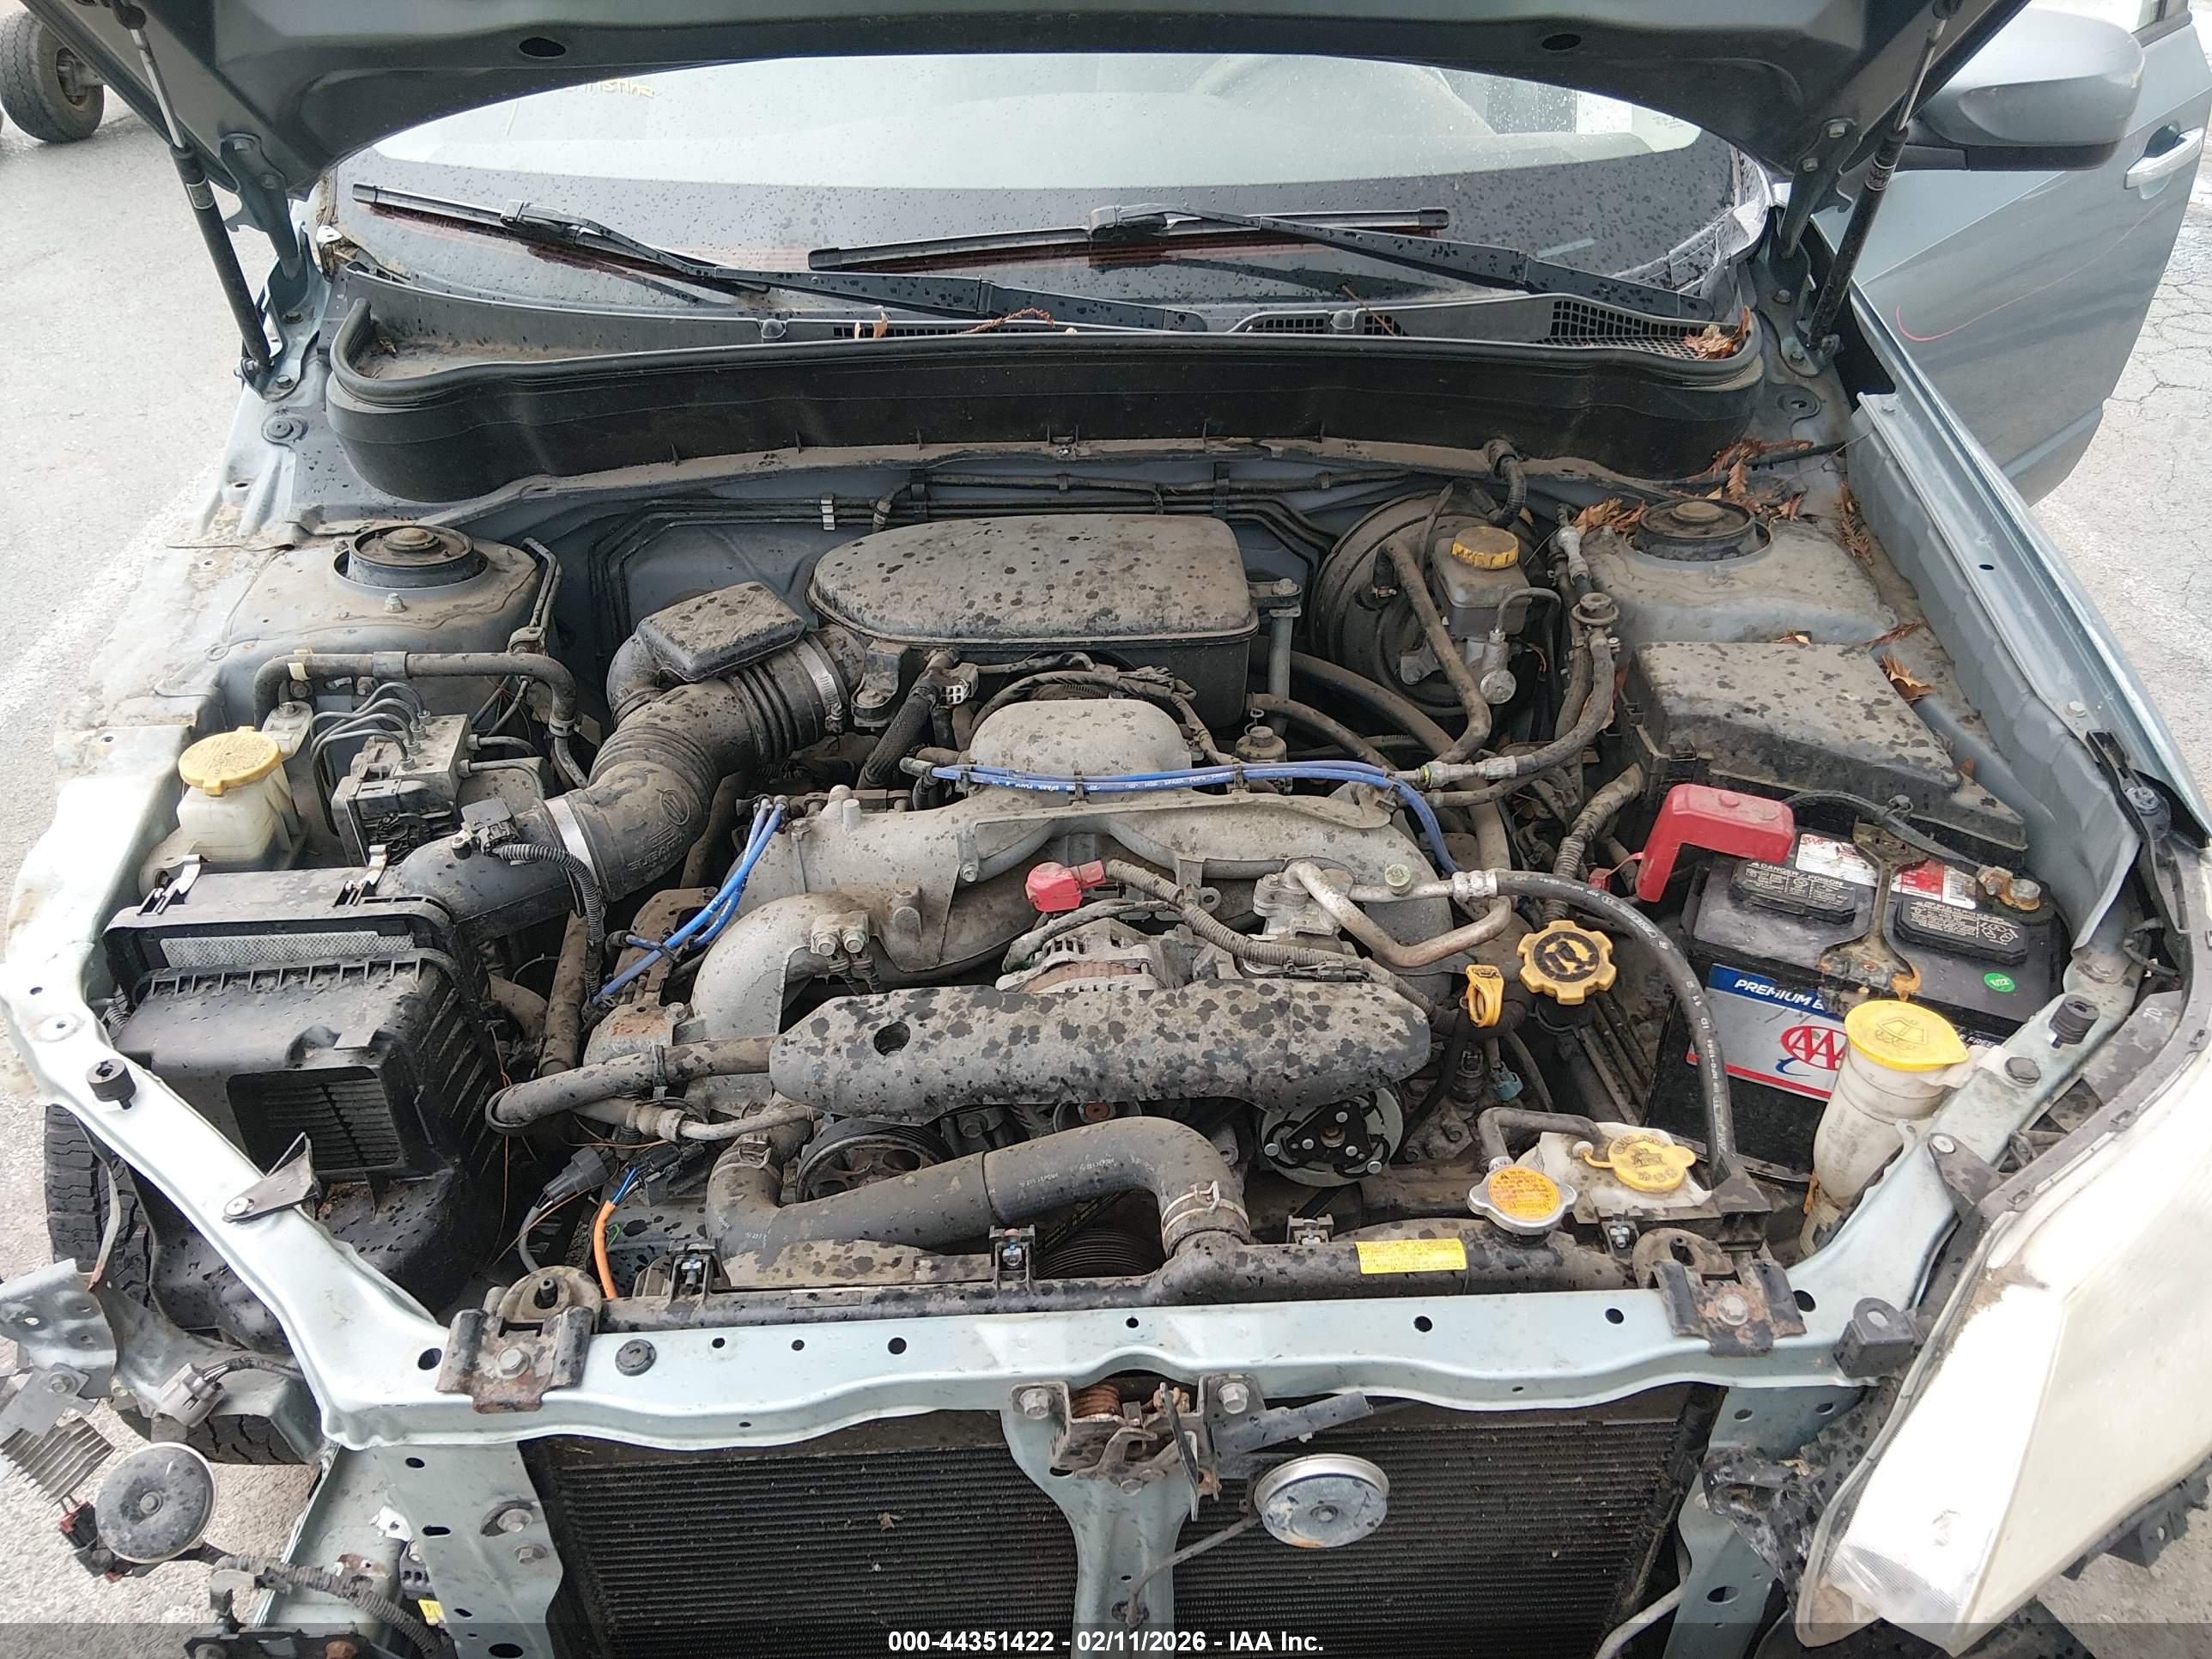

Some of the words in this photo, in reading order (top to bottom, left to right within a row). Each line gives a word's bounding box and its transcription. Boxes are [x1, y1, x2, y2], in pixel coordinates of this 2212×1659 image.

[1760, 863, 1799, 876] DANGER
[1808, 875, 1844, 887] POISON
[1734, 979, 1812, 1006] PREMIUM
[1966, 1036, 1996, 1048] FREE
